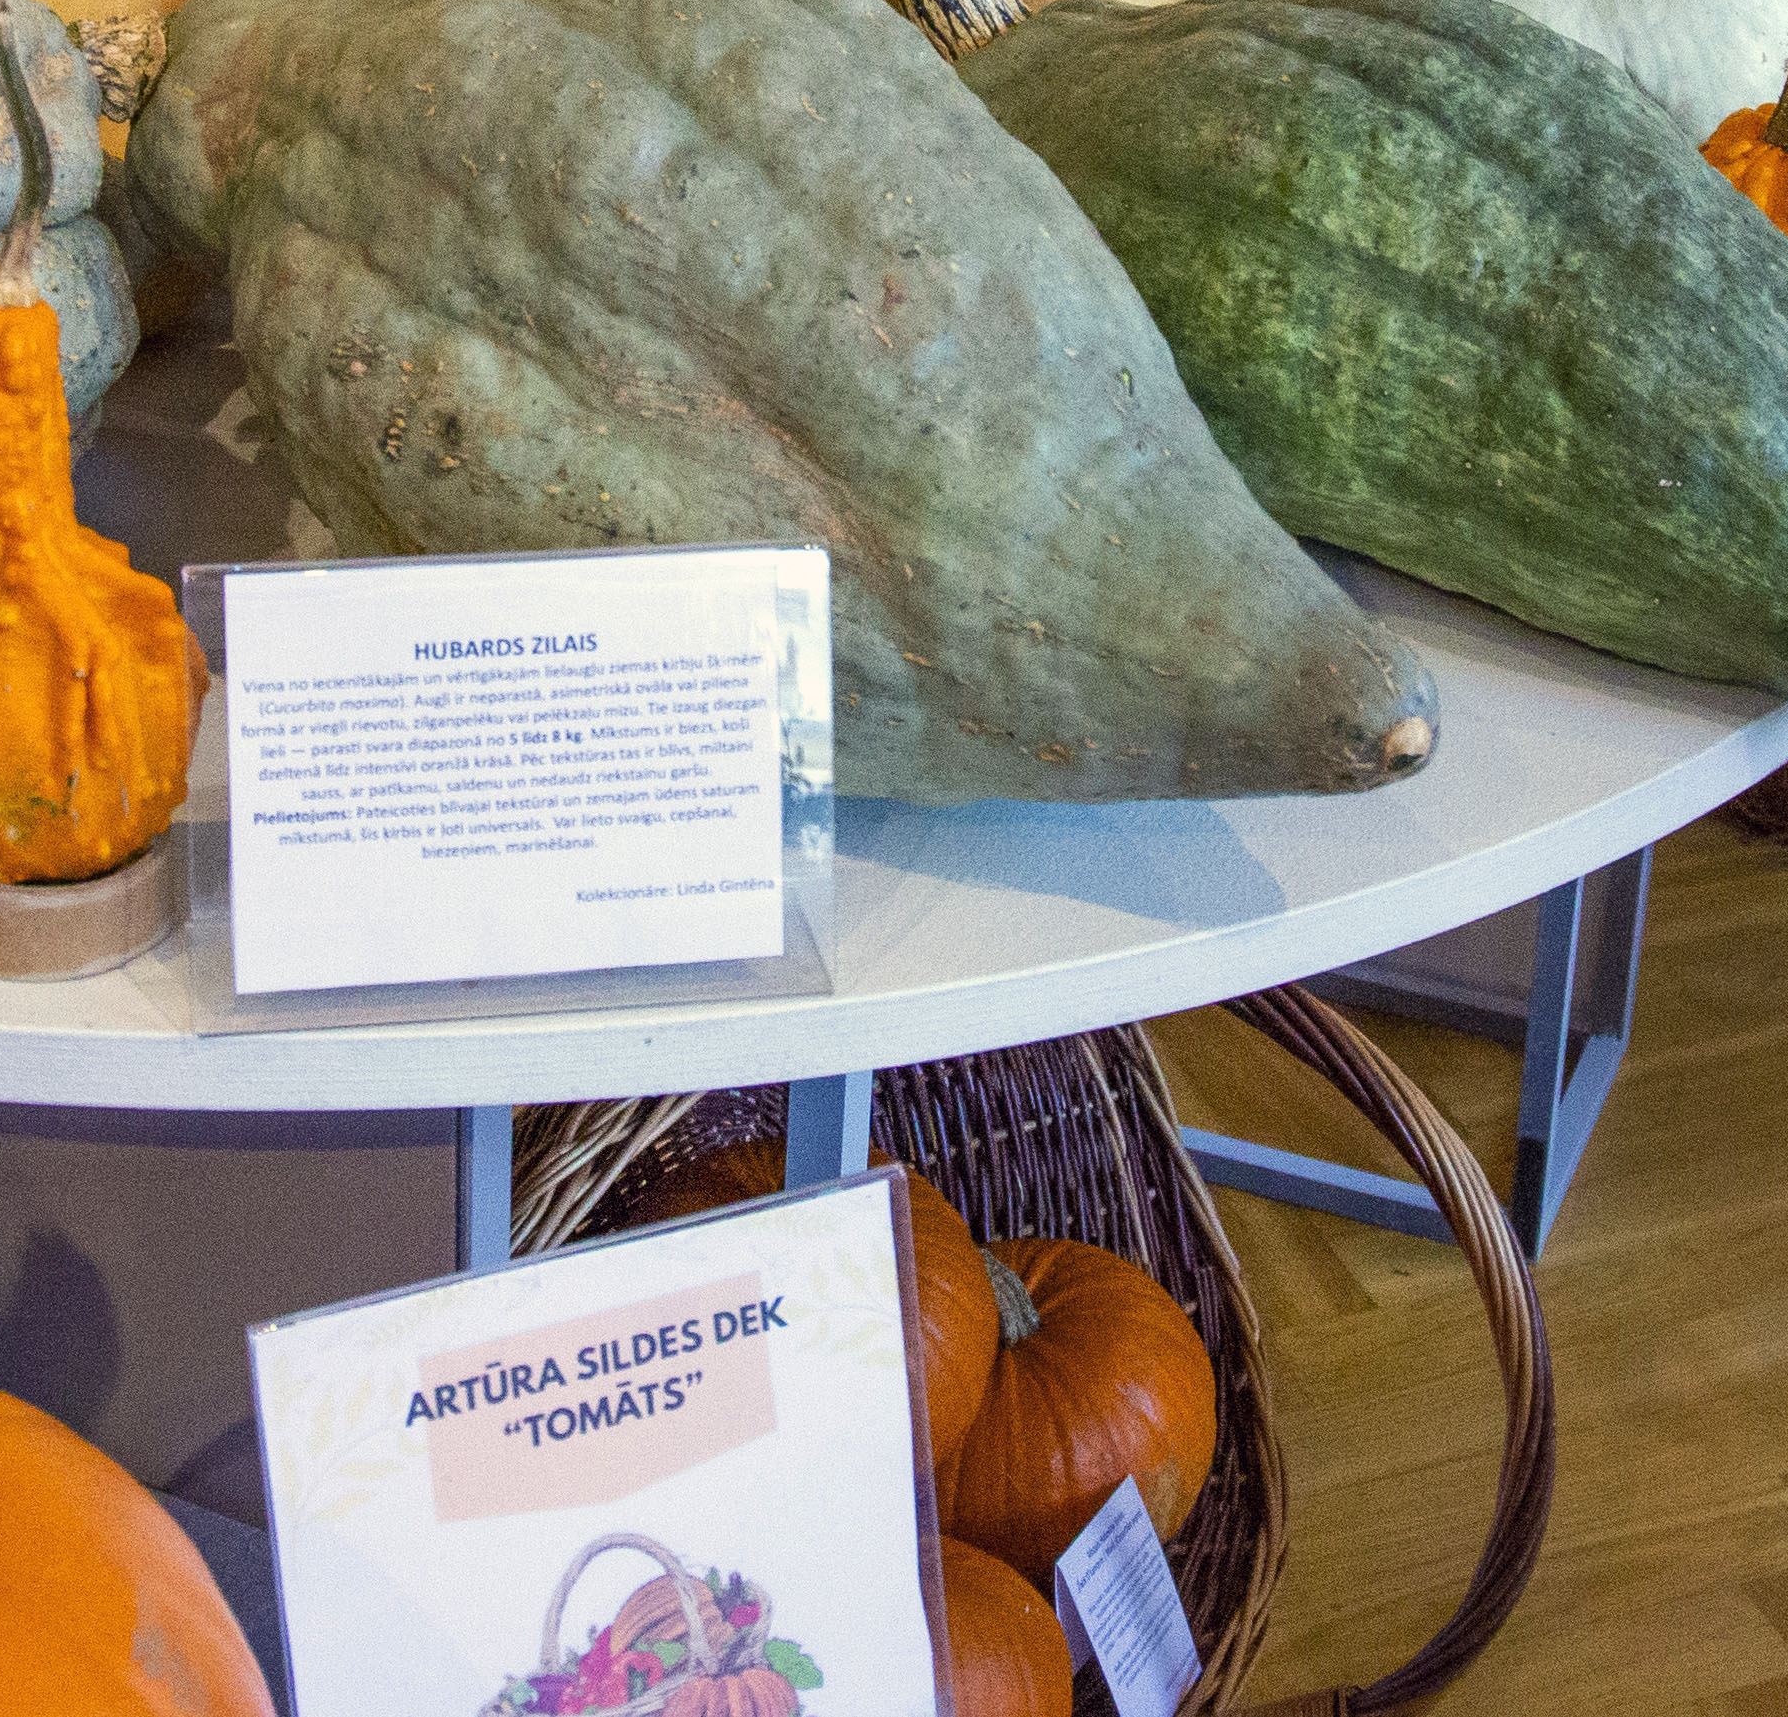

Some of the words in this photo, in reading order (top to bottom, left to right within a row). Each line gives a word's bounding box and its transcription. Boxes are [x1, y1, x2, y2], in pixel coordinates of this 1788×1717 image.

[414, 637, 525, 660] HUBARDS
[532, 633, 597, 655] ZILAIS
[406, 1358, 566, 1427] ARTŪRA
[577, 1319, 703, 1382] SILDES
[713, 1296, 791, 1346] DEK
